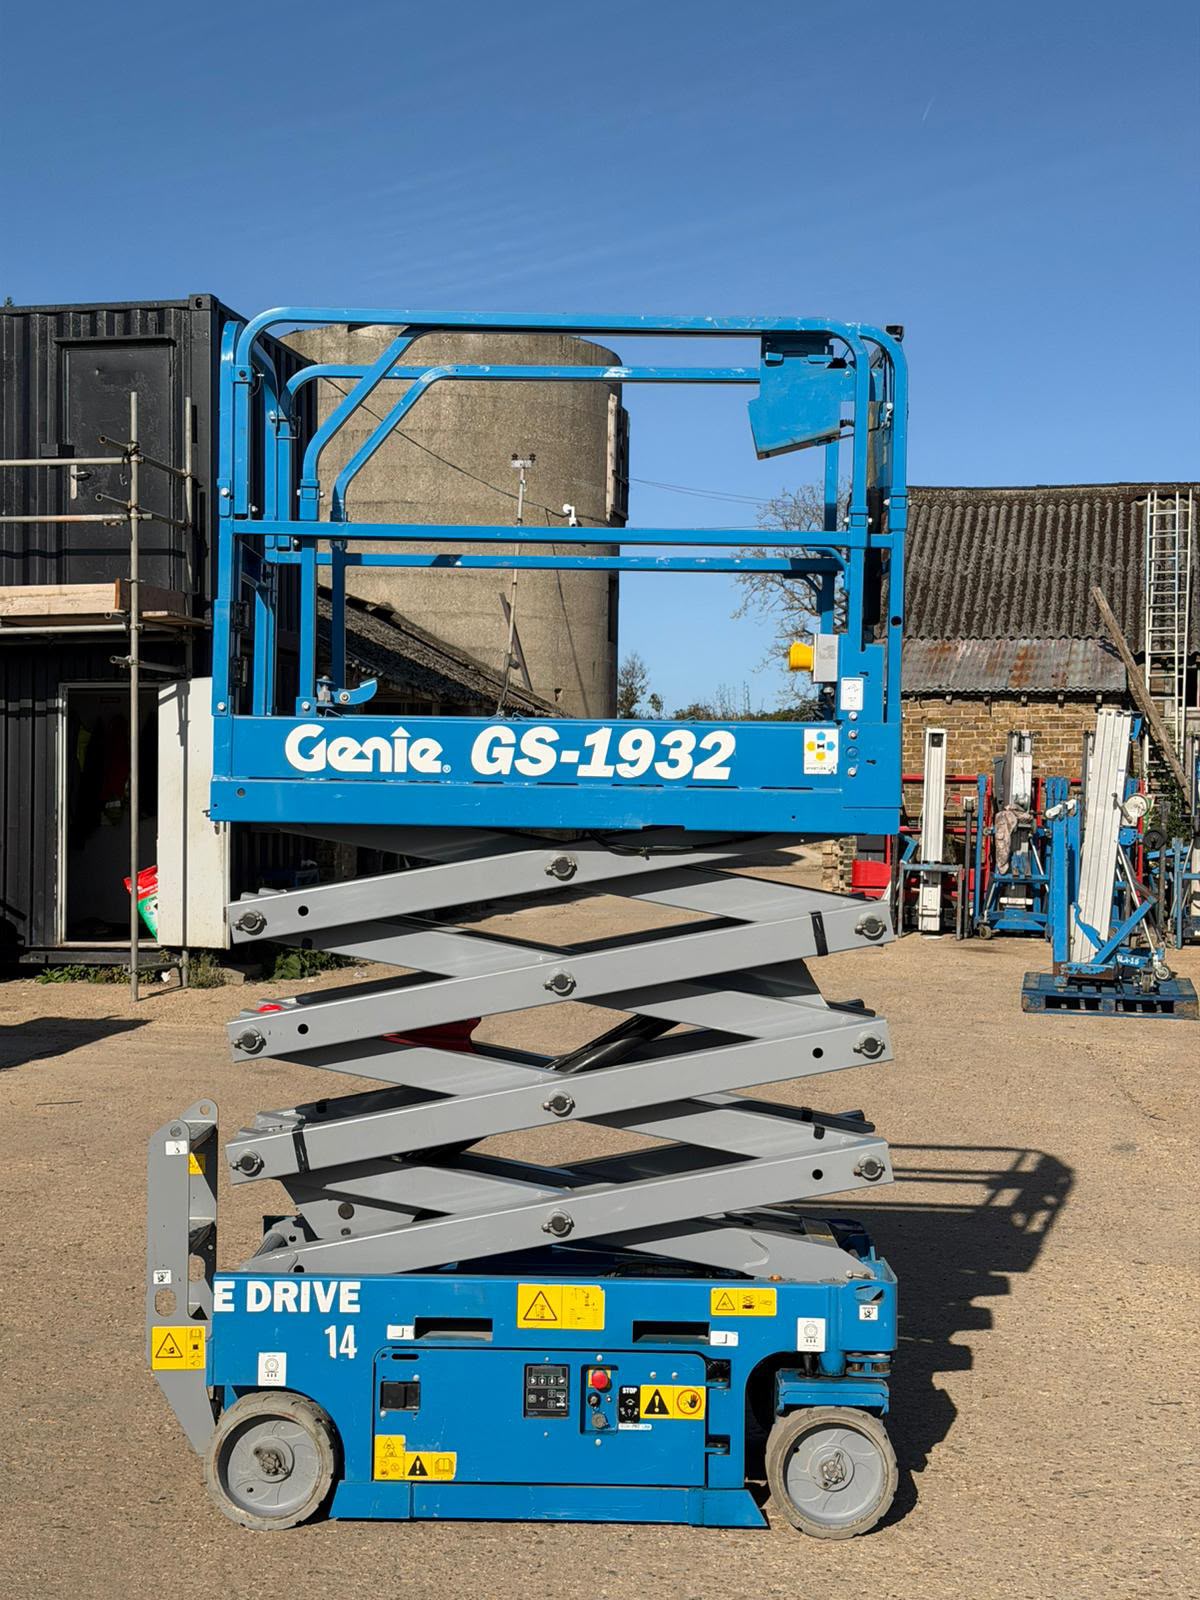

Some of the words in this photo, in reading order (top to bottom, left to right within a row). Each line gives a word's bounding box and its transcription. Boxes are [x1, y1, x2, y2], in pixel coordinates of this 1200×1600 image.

[471, 725, 736, 779] GS-1932
[213, 1280, 235, 1312] E
[246, 1280, 361, 1313] DRIVE
[324, 1324, 357, 1360] 14
